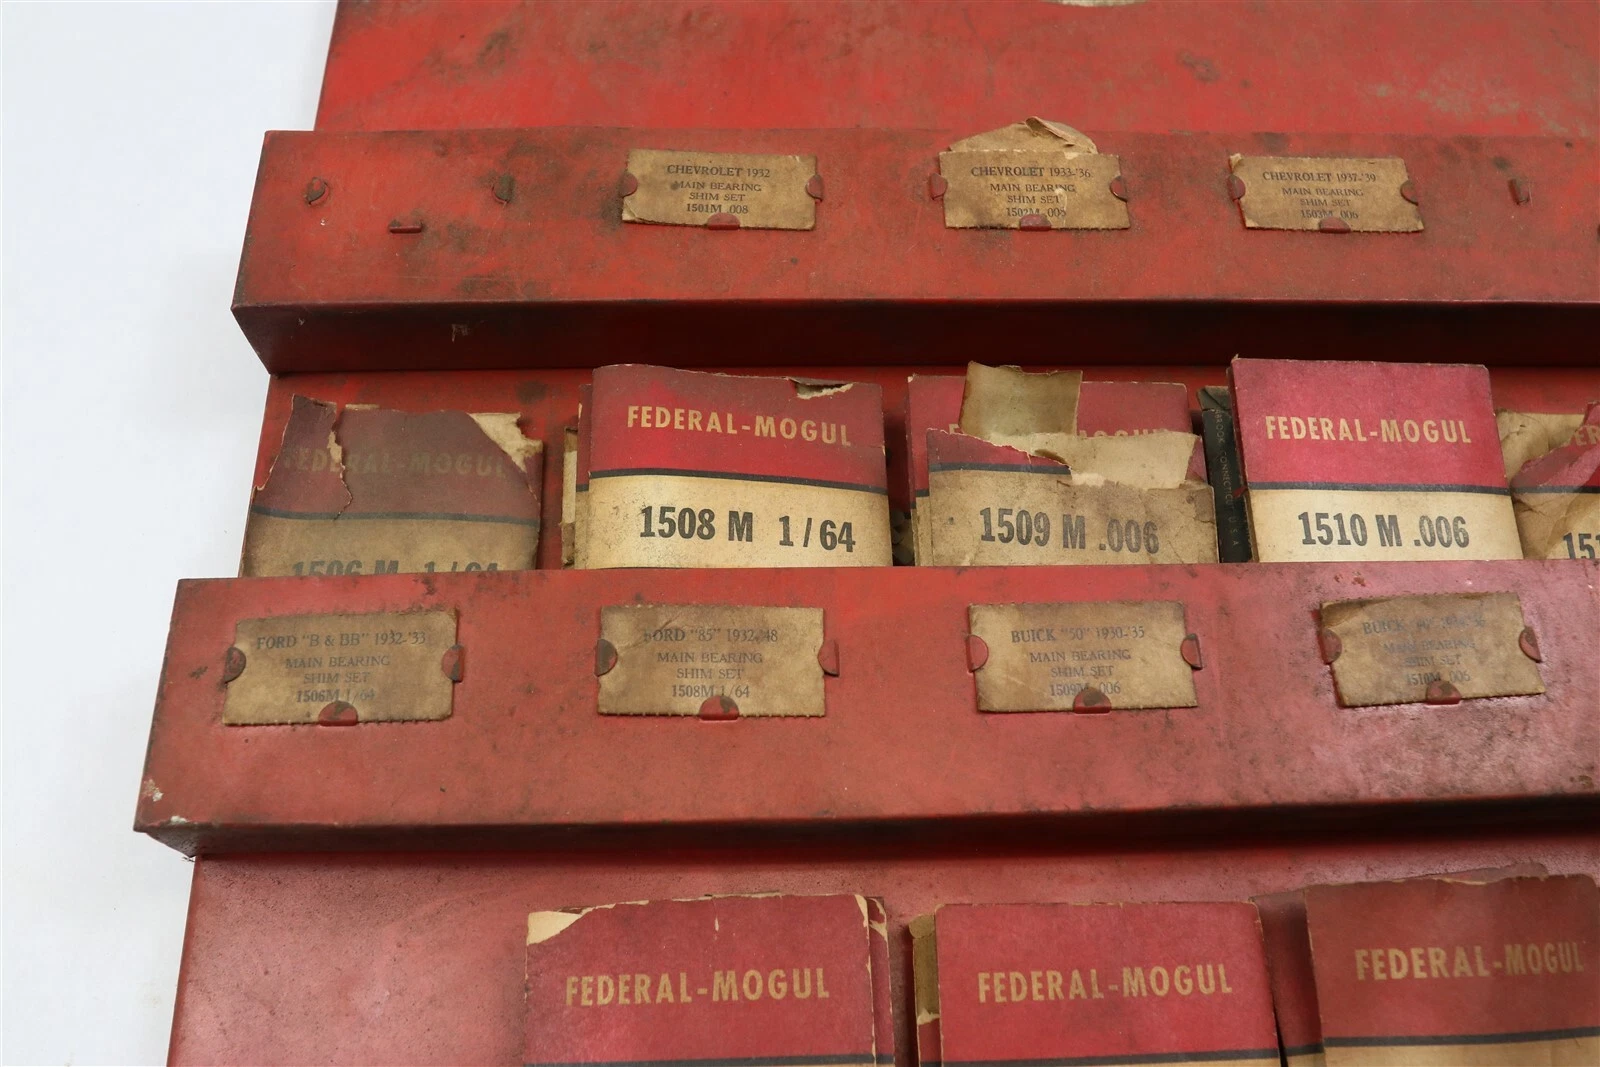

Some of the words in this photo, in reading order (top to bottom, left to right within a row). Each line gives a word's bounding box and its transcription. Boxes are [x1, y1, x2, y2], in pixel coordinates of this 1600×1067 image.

[667, 164, 743, 177] CHEVROLET
[747, 168, 770, 178] 1932
[971, 166, 1045, 177] CHEVROLET
[1262, 172, 1333, 182] CHEVROLET
[677, 181, 705, 190] MAIN
[710, 182, 762, 191] BEARING
[990, 183, 1020, 192] MAIN
[1025, 184, 1076, 193] BEARING
[1282, 187, 1311, 196] MAIN
[1316, 188, 1364, 196] BEARING
[689, 192, 719, 200] SHIM
[1007, 195, 1036, 204] SHIM
[1040, 196, 1061, 204] SET
[686, 203, 722, 213] 1501M
[726, 205, 748, 214] .008
[1332, 199, 1352, 207] SET
[627, 405, 851, 446] FEDERAL-MOGUL
[1265, 415, 1471, 444] FEDERAL-MOGUL
[640, 505, 715, 540] 1508
[728, 511, 753, 542] M
[1297, 511, 1368, 546] 1510
[1375, 514, 1402, 546] M
[1414, 515, 1469, 548] .006
[980, 507, 1050, 546] 1509
[1062, 514, 1086, 549] M
[1099, 519, 1160, 554] .006
[644, 628, 686, 642] FORD
[1011, 628, 1056, 643] BUICK
[257, 635, 297, 649] FORD
[324, 635, 335, 646] &
[285, 657, 322, 668] MAIN
[329, 655, 390, 667] BEARING
[657, 653, 695, 663] MAIN
[701, 653, 763, 663] BEARING
[1030, 651, 1066, 663] MAIN
[1072, 649, 1131, 661] BEARING
[303, 673, 340, 684] SHIM
[345, 672, 371, 683] SET
[677, 669, 713, 679] SHIM
[718, 669, 746, 679] SET
[1051, 667, 1084, 678] SHIM
[1090, 666, 1114, 677] SET
[296, 690, 340, 703] 1506M
[672, 685, 714, 697] 1508M
[1355, 941, 1584, 981] FEDERAL-MOGUL
[565, 967, 829, 1006] FEDERAL-MOGUL
[977, 963, 1233, 1003] FEDERAL-MOGUL
